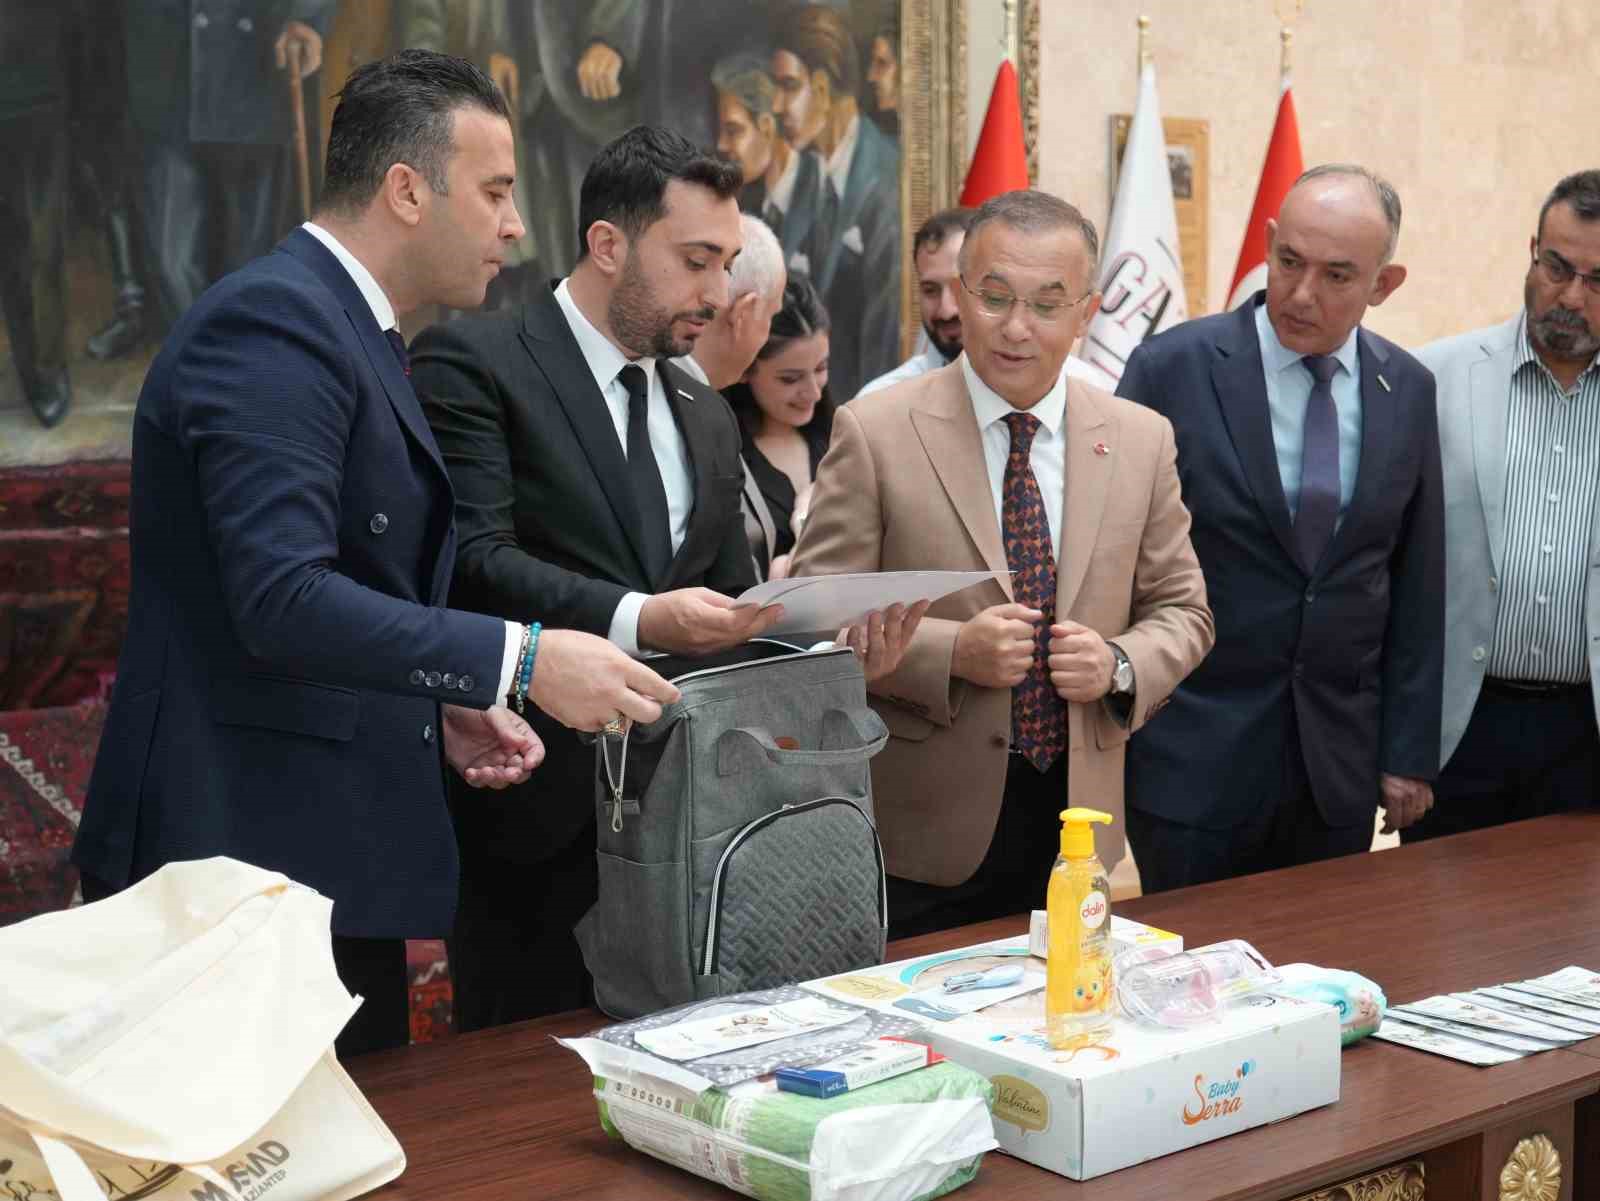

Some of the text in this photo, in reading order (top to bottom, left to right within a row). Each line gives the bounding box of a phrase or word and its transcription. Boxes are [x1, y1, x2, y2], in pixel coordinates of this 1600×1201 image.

[1081, 901, 1105, 919] dalin
[1183, 1073, 1242, 1126] Serra
[1207, 1079, 1240, 1100] Baby
[189, 1139, 290, 1201] MSİAD
